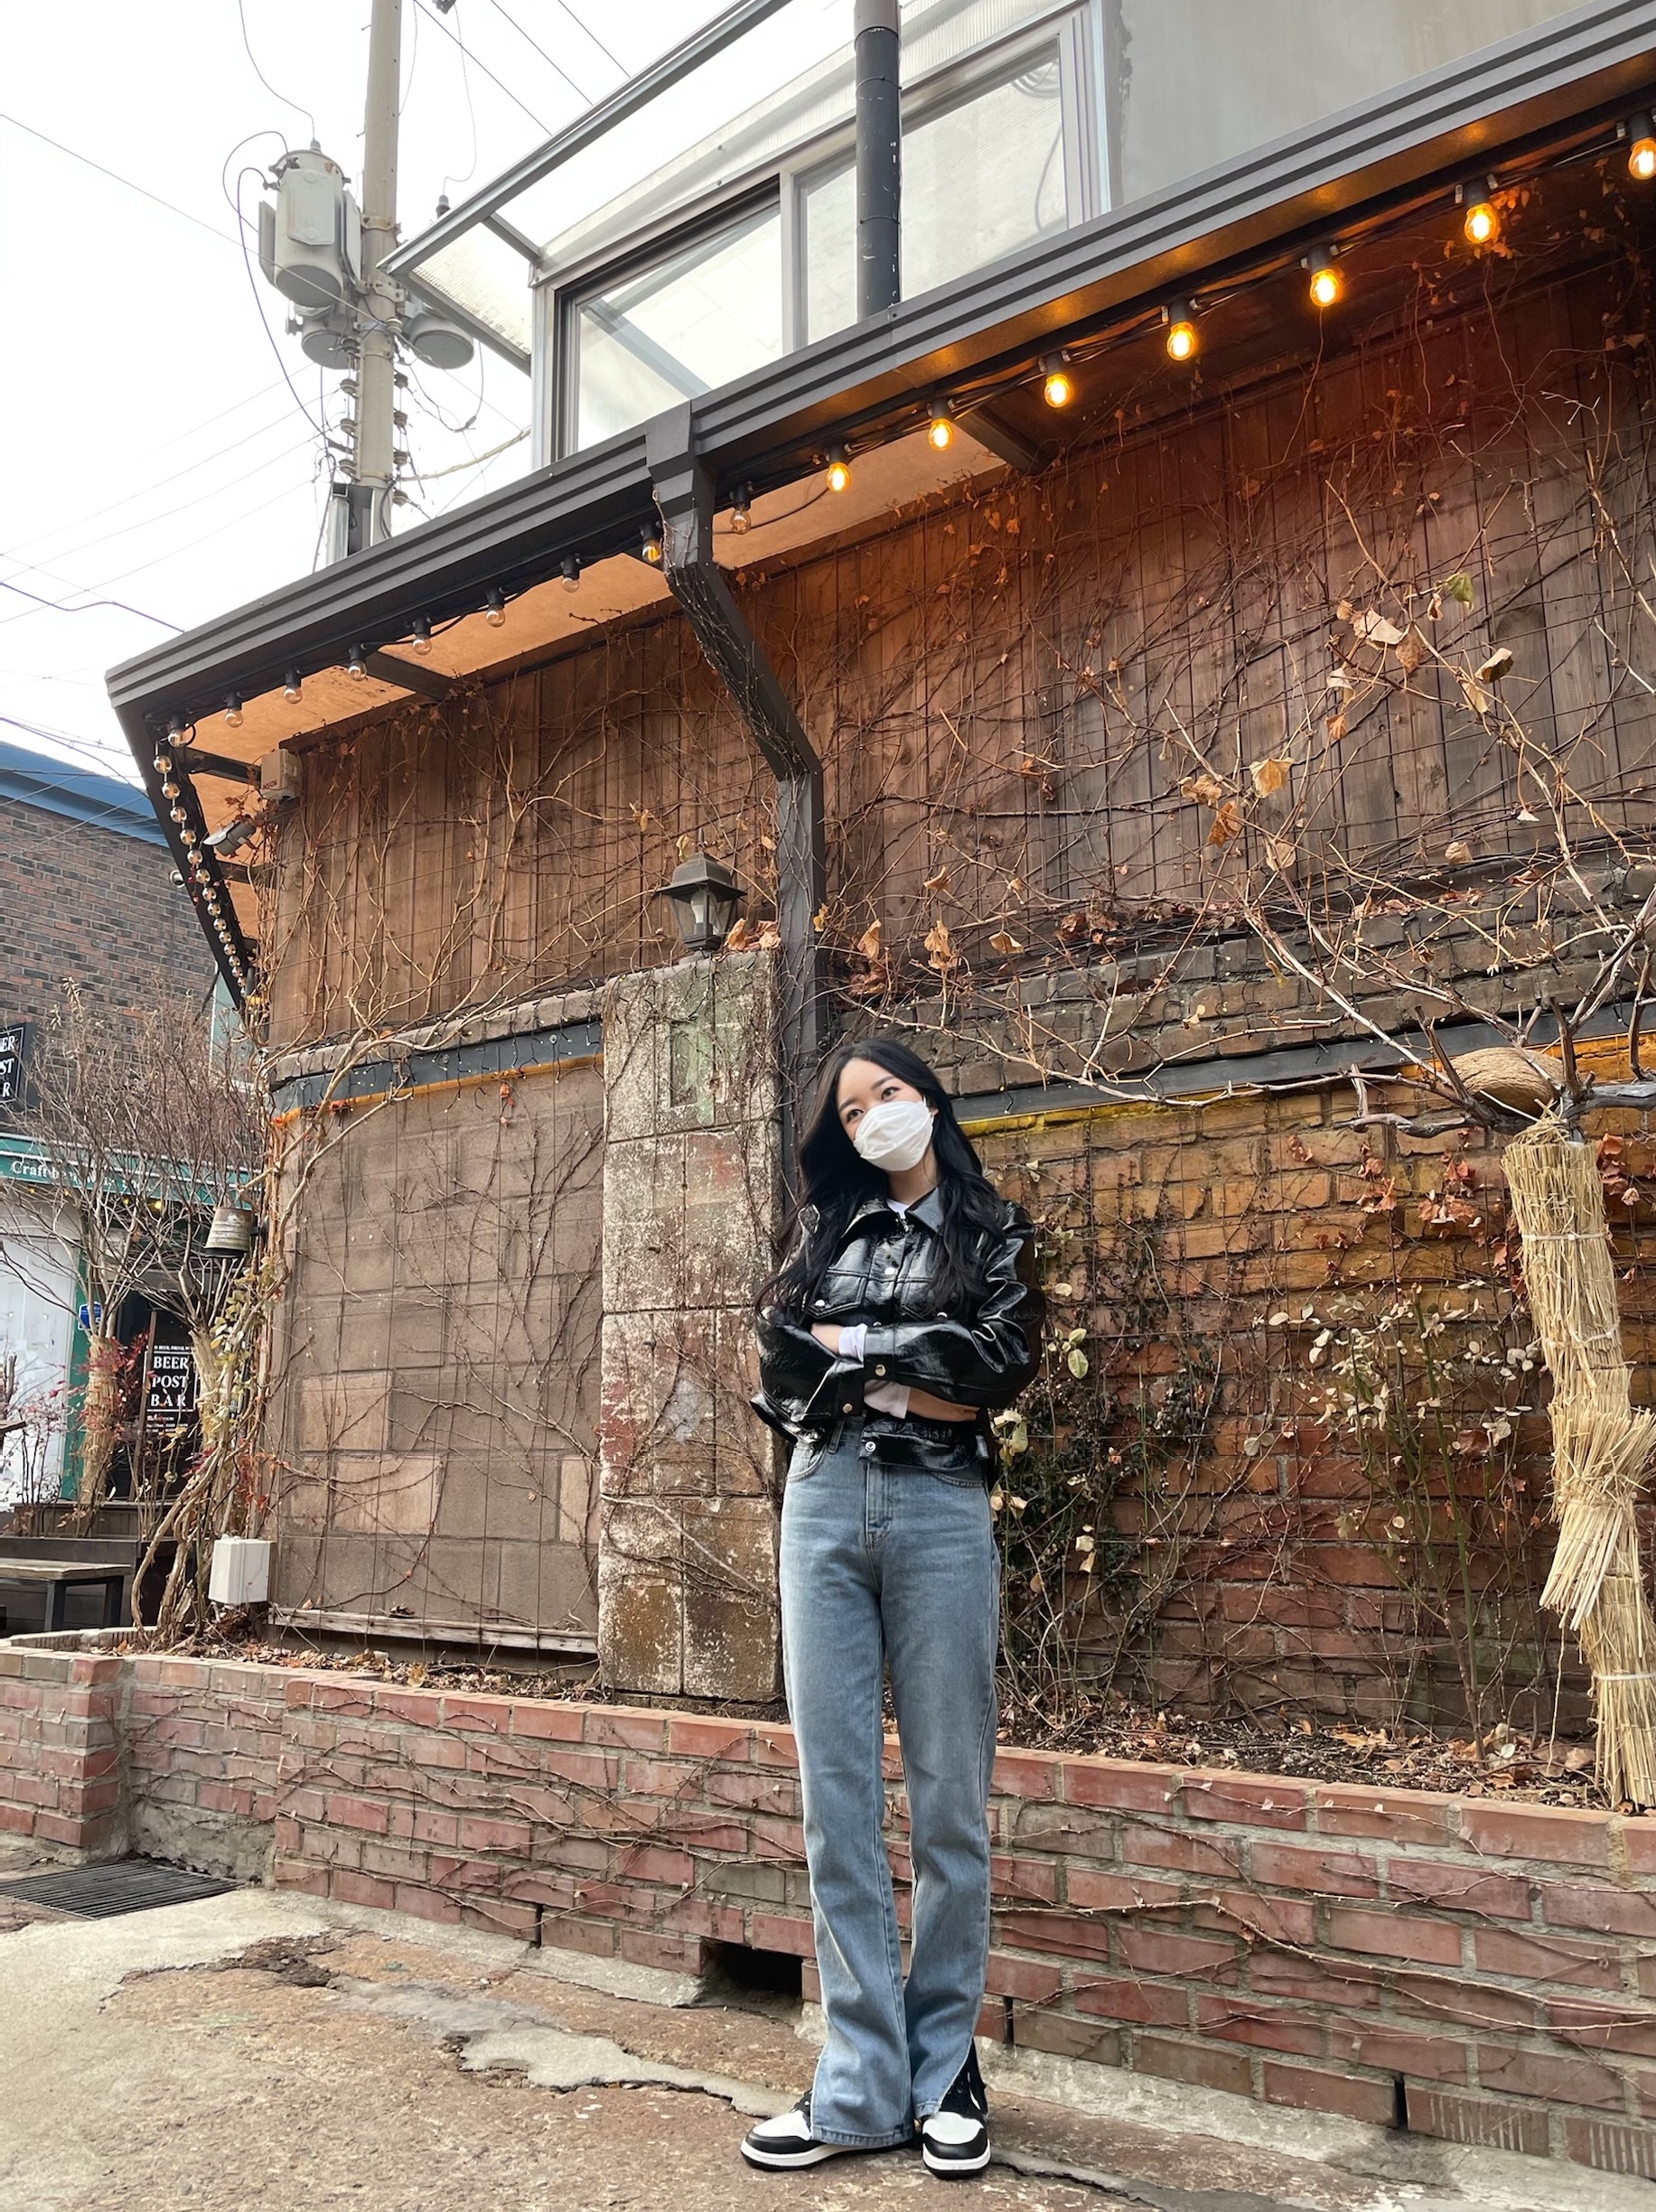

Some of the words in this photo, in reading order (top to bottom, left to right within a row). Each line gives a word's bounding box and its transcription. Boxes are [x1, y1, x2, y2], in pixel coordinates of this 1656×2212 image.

[11, 1161, 48, 1178] Craft
[154, 1356, 189, 1370] BEER
[152, 1375, 187, 1388] POST
